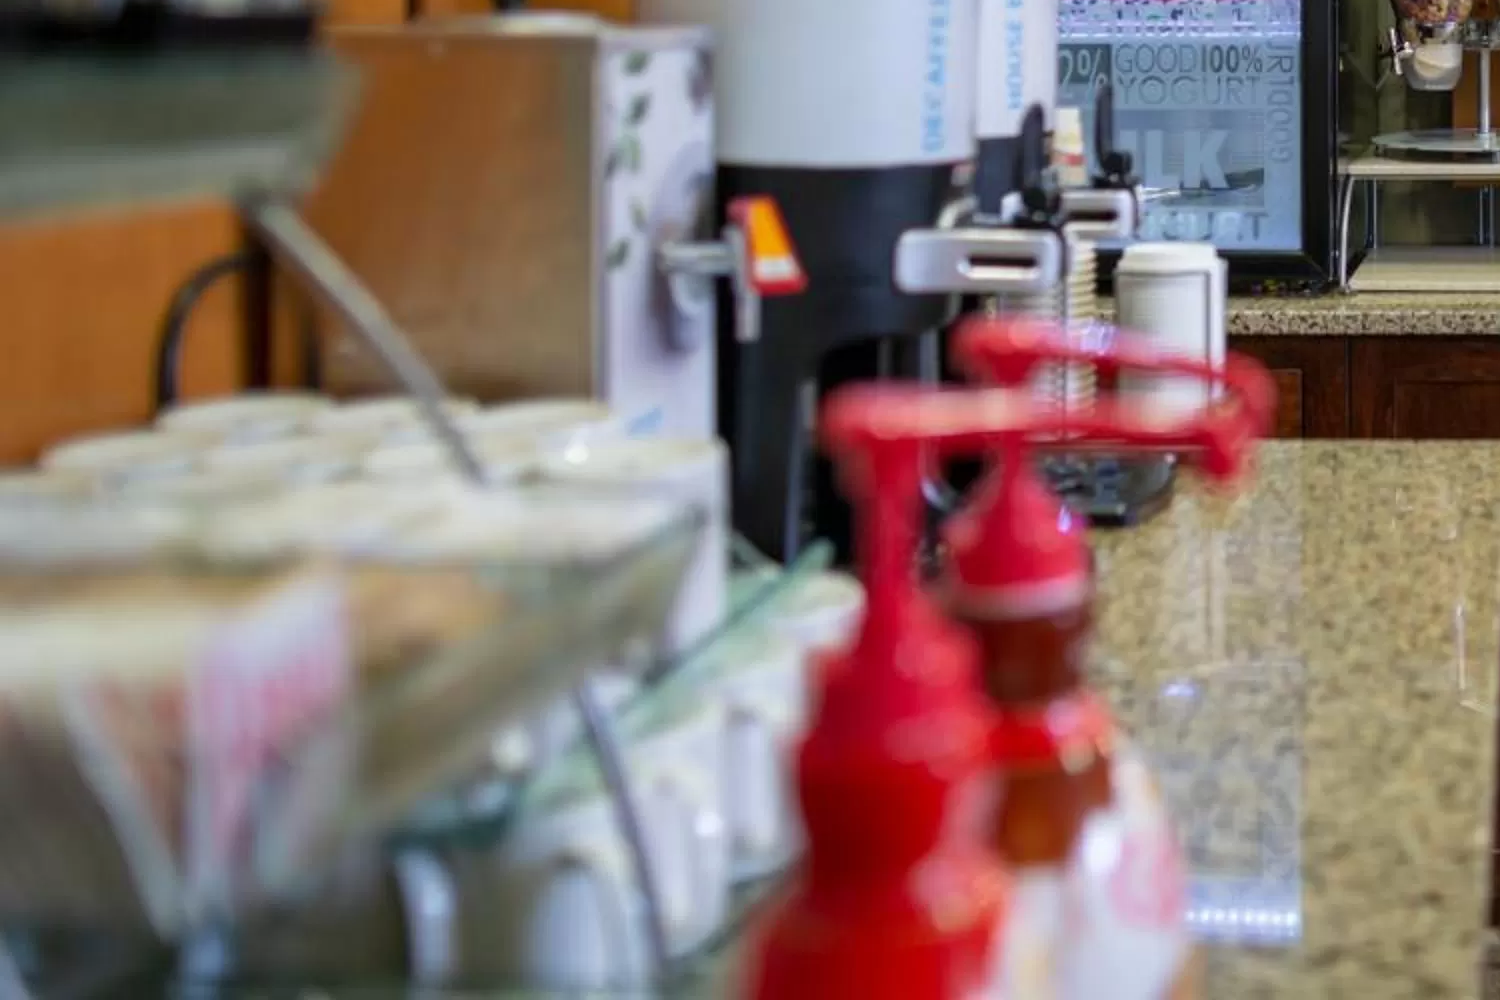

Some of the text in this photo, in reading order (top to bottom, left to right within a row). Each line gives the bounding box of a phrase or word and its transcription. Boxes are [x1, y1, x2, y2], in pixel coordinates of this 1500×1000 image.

[1004, 20, 1025, 111] HOUSE
[1115, 43, 1263, 73] GOOD 100%
[1116, 75, 1260, 105] YOGURT
[1267, 88, 1294, 163] GOOD
[1119, 130, 1229, 189] ILK
